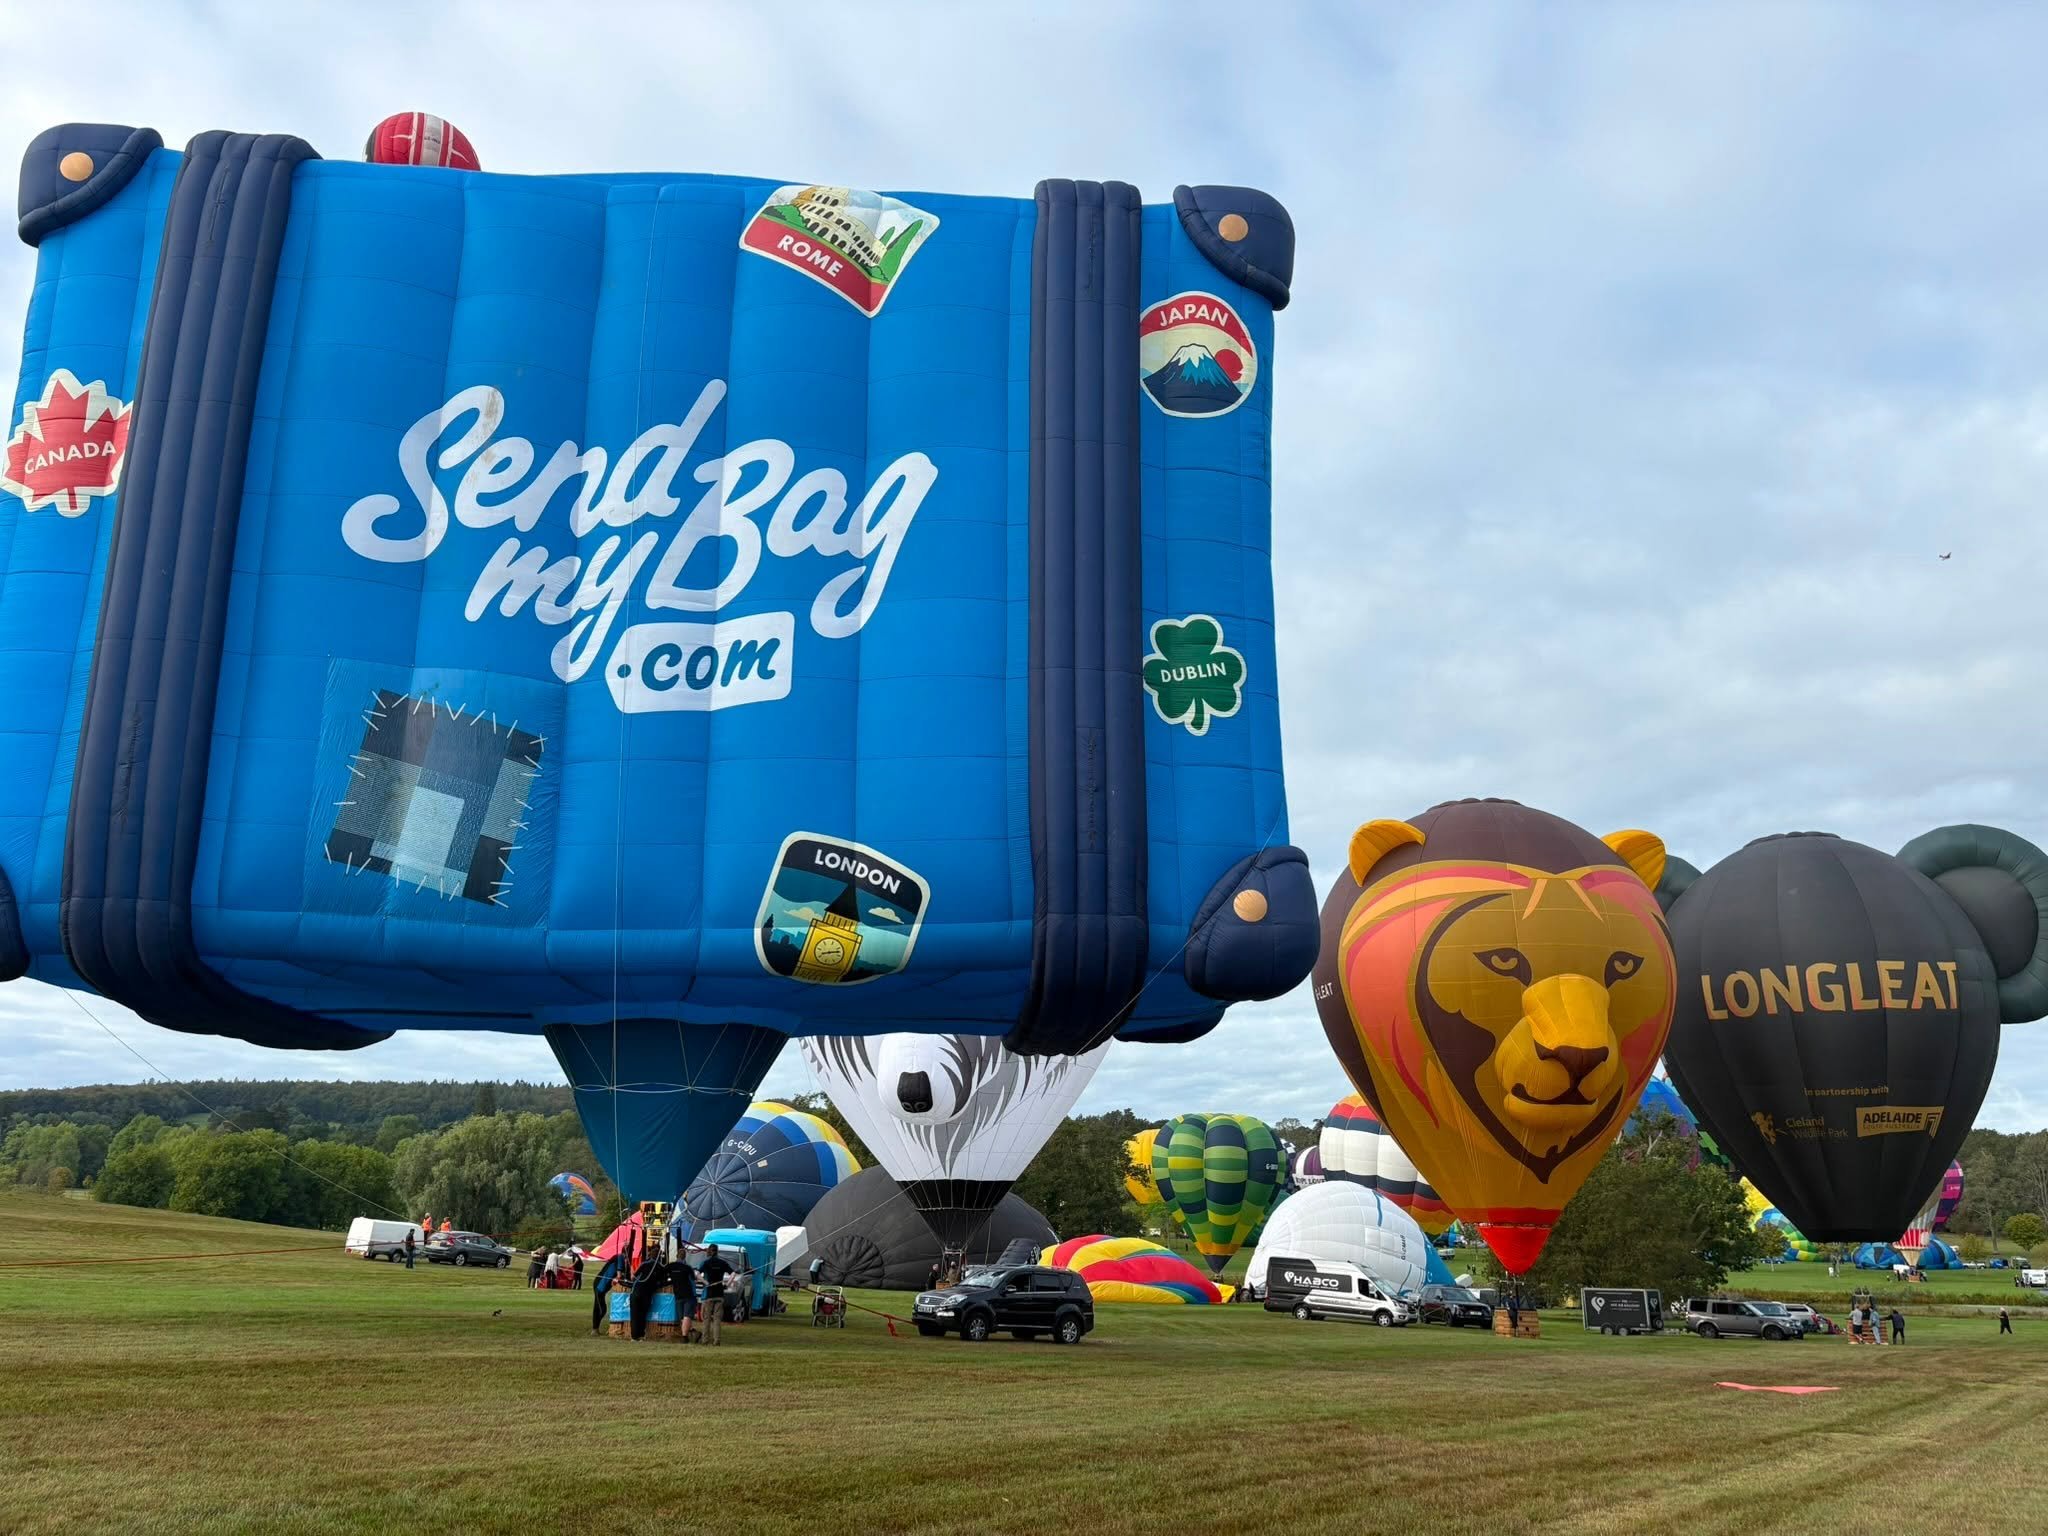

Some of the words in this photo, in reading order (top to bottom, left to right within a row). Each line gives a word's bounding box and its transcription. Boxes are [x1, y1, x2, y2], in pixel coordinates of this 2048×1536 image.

[776, 234, 844, 277] ROME
[1159, 303, 1229, 327] JAPAN
[24, 440, 117, 475] CANADA
[341, 378, 727, 562] Send
[645, 438, 939, 638] Bag
[464, 531, 658, 682] my
[616, 638, 776, 691] .com
[1160, 661, 1227, 683] DUBLIN
[814, 849, 901, 895] LONDON
[1701, 960, 1961, 1020] LONGLEAT
[1871, 1085, 1889, 1095] with
[1828, 1127, 1849, 1138] Park
[1863, 1111, 1923, 1124] ADELAIDE
[1294, 1276, 1339, 1287] HABCO
